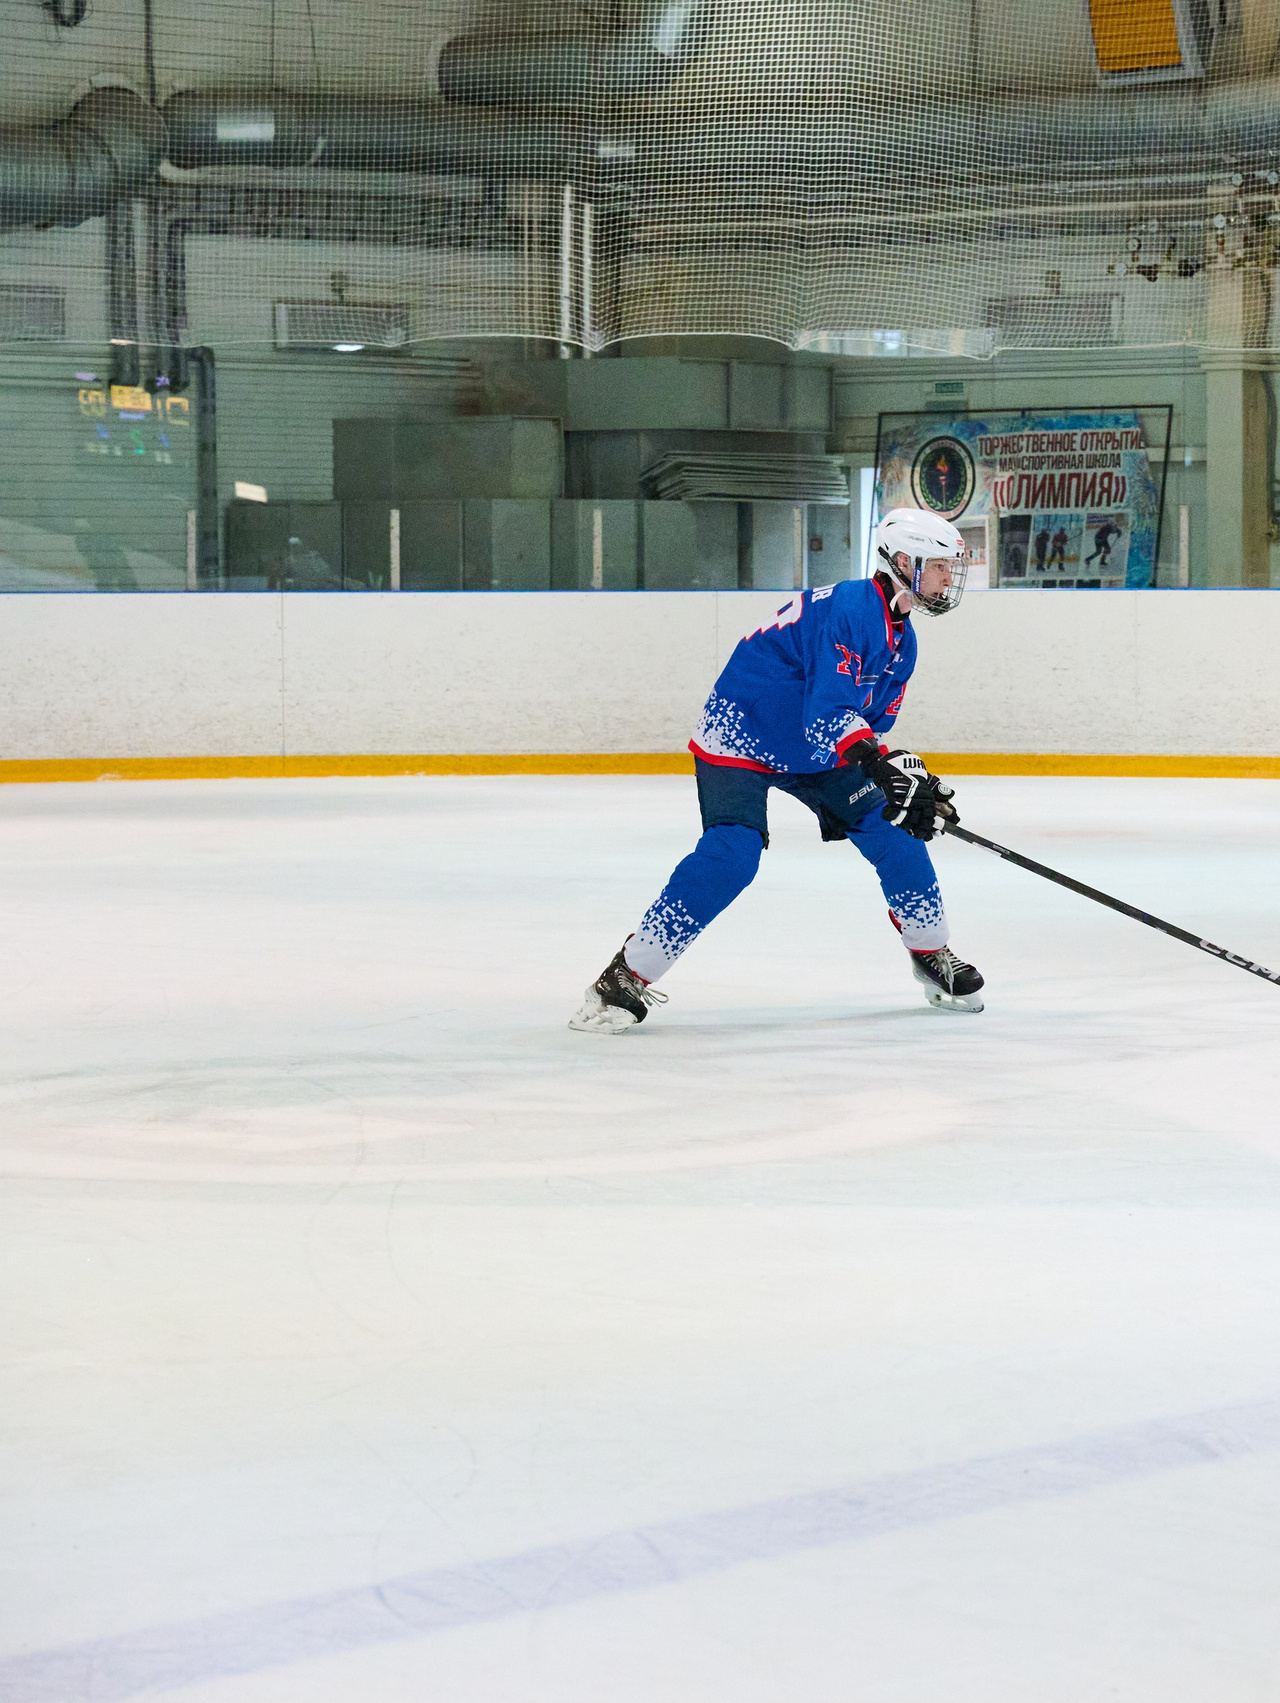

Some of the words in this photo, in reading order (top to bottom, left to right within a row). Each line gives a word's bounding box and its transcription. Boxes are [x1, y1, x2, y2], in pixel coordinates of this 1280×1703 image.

[978, 432, 1078, 457] ТОРЖЕСТВЕННОЕ
[1085, 453, 1121, 469] ШКОЛА
[1199, 939, 1280, 981] CCM
